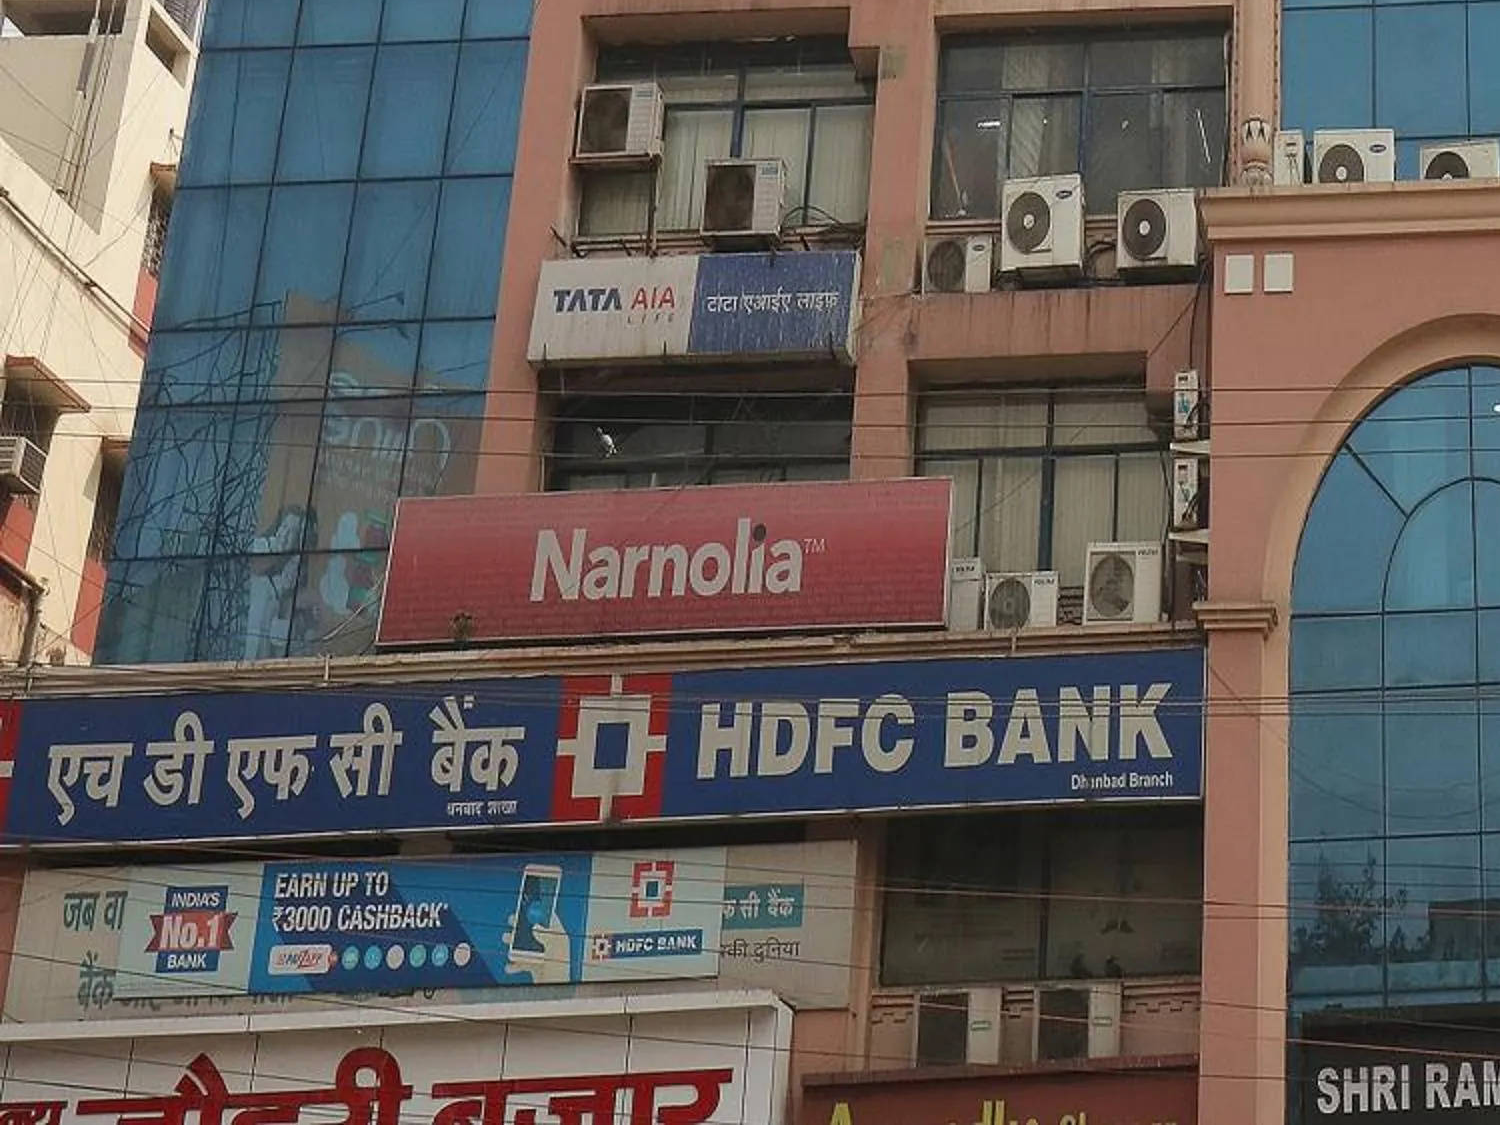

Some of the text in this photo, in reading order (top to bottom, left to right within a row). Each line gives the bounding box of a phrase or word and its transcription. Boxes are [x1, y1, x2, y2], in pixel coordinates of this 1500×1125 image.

[553, 286, 675, 313] TATA AIA
[706, 292, 738, 313] टाटा
[529, 518, 803, 603] Narnolia
[697, 682, 1174, 780] HDFC BANK
[47, 695, 526, 826] एच डी एफ सी बैंक
[1129, 771, 1174, 788] Branch
[274, 871, 390, 898] EARN UP TO
[171, 891, 221, 908] INDIA'S
[157, 912, 221, 951] No.1
[272, 906, 331, 933] ₹3000
[614, 934, 698, 953] HDFC BANK
[752, 936, 801, 964] दुनिया
[167, 953, 208, 969] BANK
[1316, 1065, 1411, 1114] SHRI
